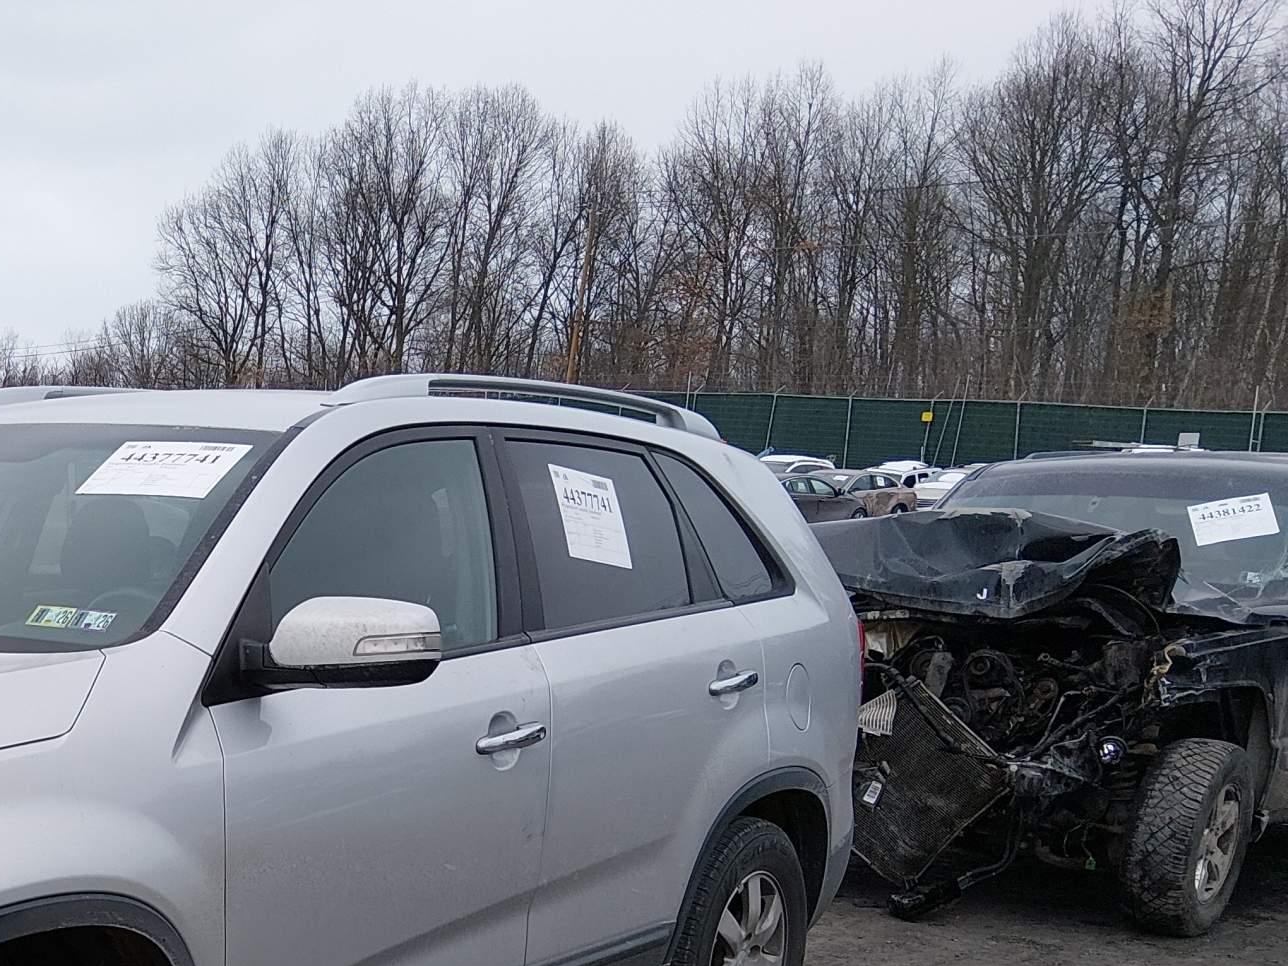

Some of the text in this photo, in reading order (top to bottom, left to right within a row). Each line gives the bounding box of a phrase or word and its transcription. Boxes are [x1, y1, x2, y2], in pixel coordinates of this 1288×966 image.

[120, 452, 222, 465] 44377741
[562, 487, 614, 513] 44377741
[1199, 503, 1264, 521] 44381422
